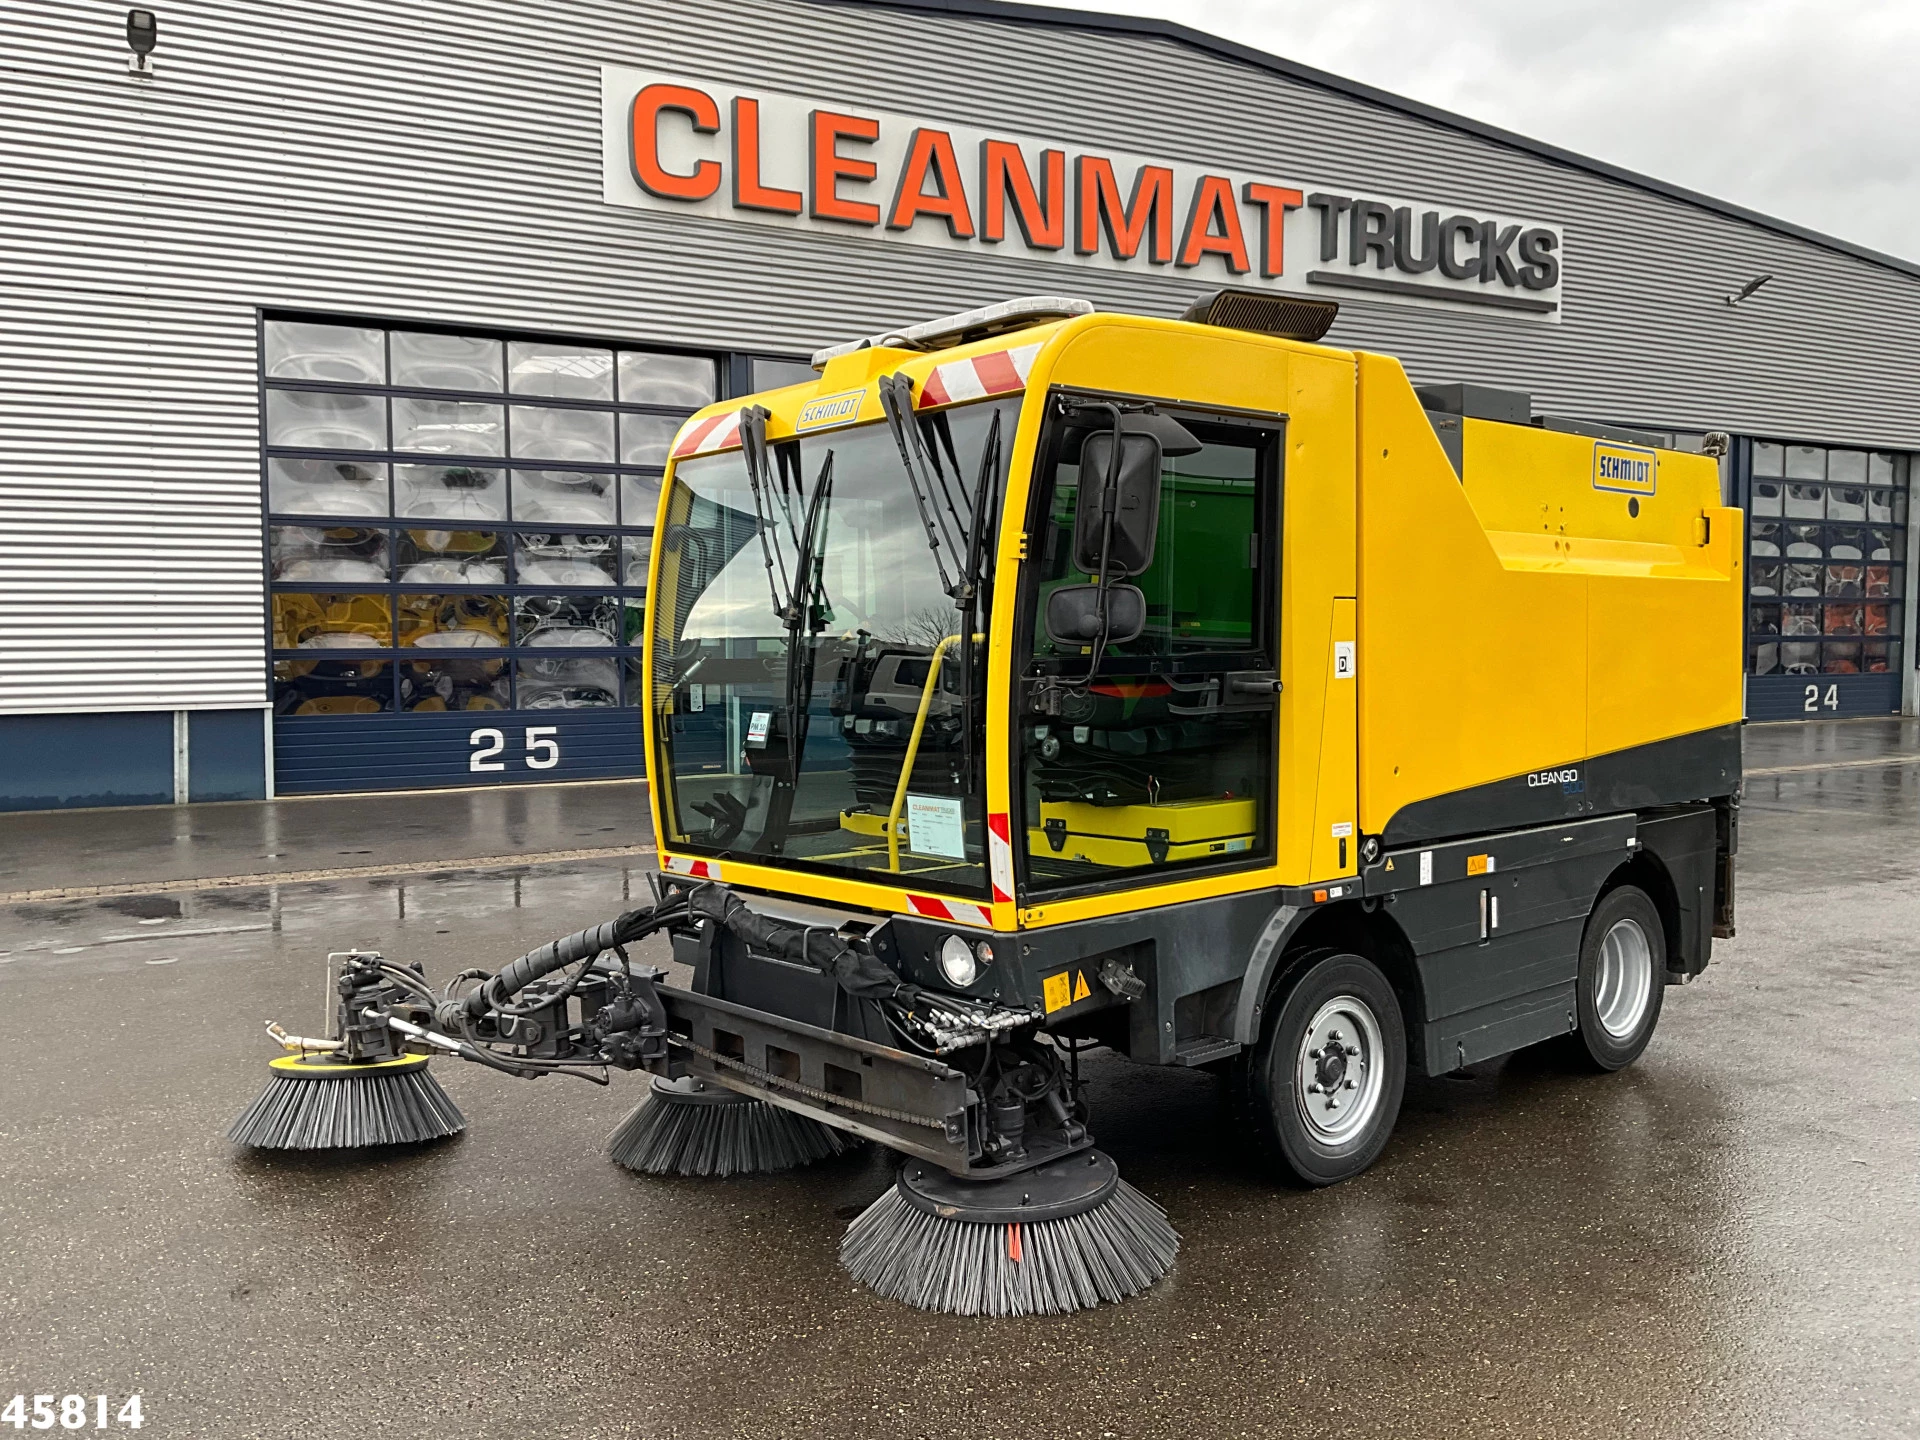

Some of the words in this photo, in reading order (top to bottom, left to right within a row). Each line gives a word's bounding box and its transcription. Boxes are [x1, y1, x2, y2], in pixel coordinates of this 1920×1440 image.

[629, 84, 1304, 278] CLEANMAT
[1307, 192, 1559, 290] TRUCKS
[802, 398, 857, 422] SCHMIDT
[1600, 455, 1650, 483] SCHMIDT
[1804, 684, 1839, 712] 24
[469, 726, 559, 772] 25
[1527, 769, 1578, 787] CLEANGO
[912, 804, 940, 812] CLEANMAT
